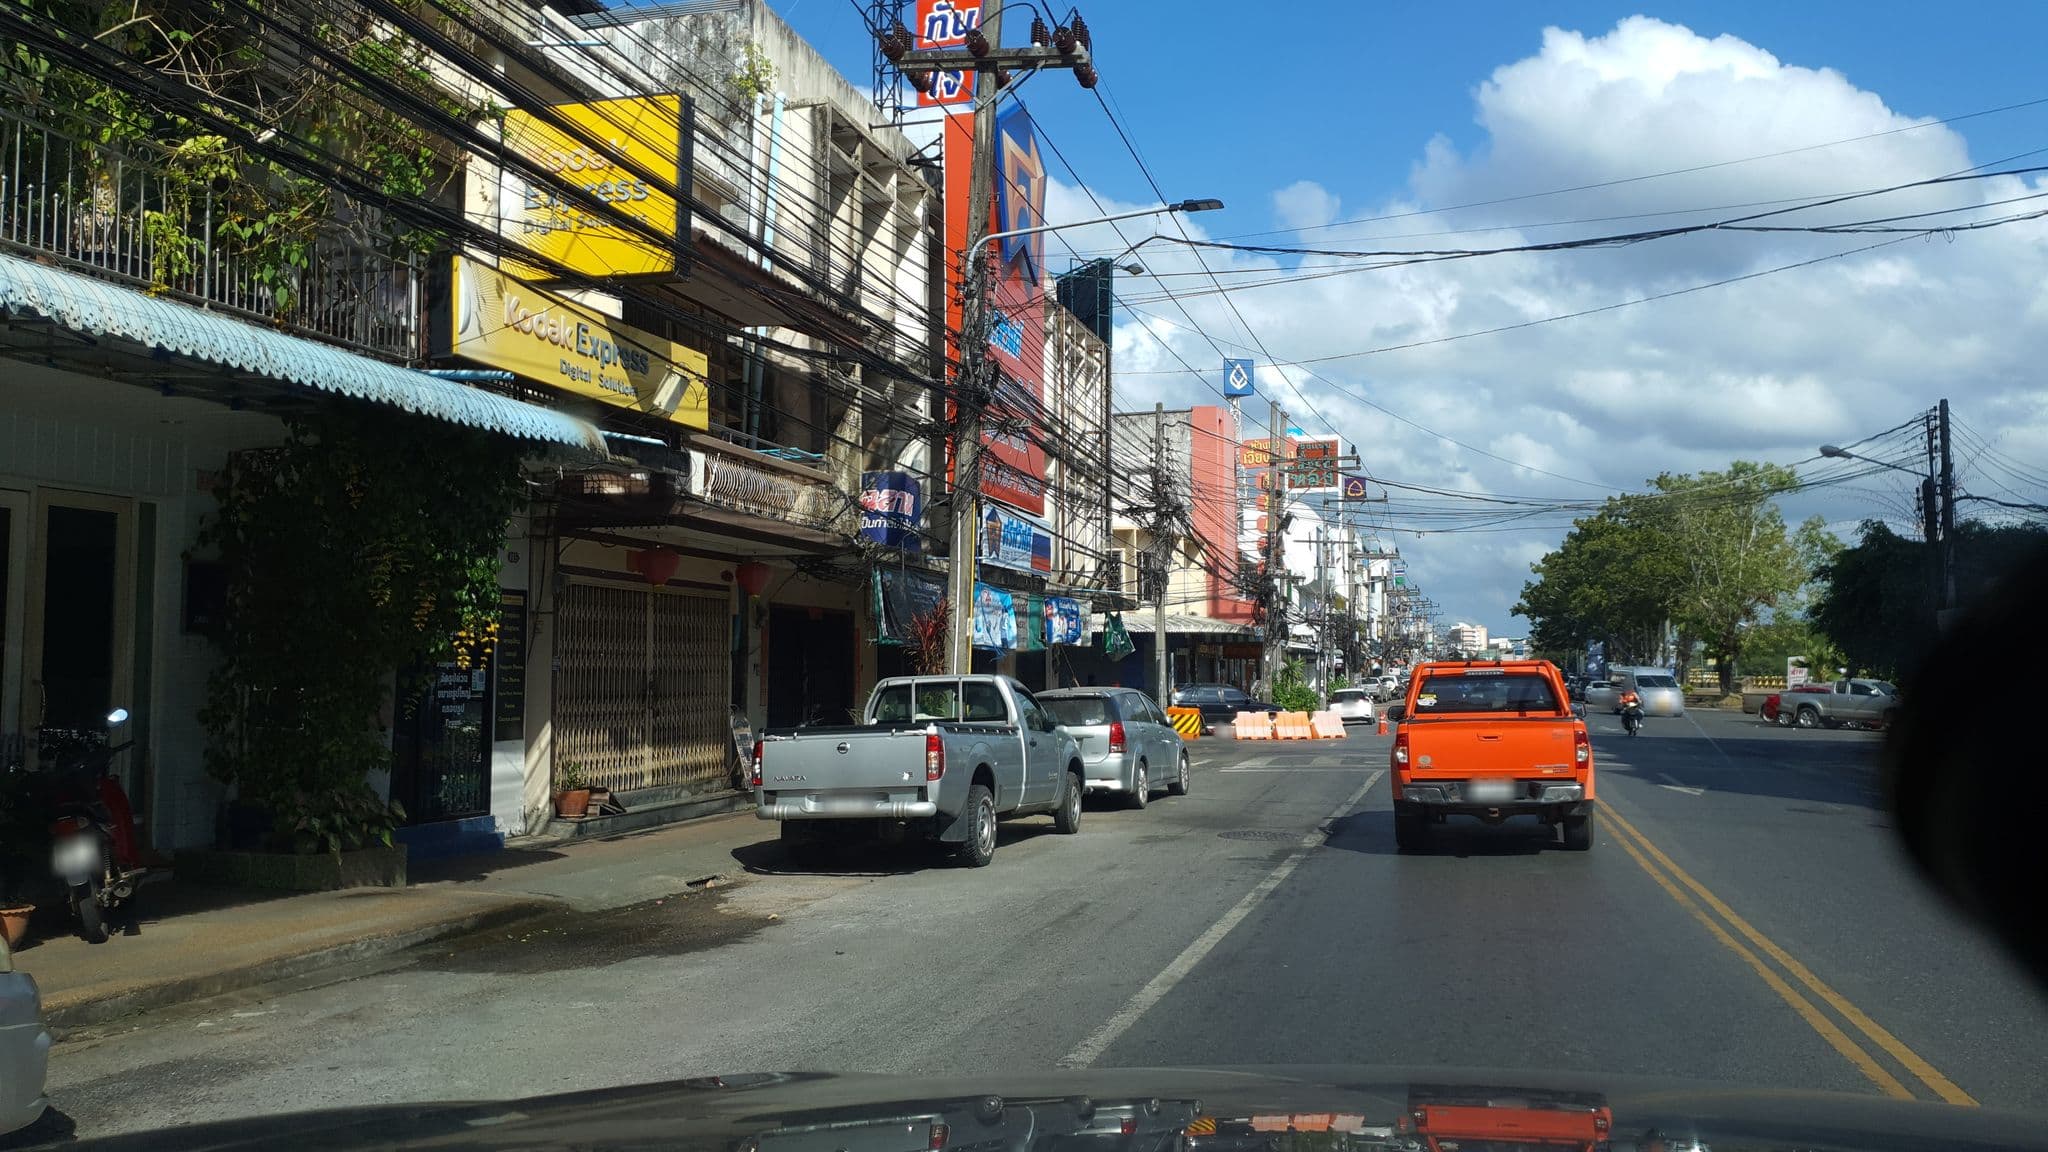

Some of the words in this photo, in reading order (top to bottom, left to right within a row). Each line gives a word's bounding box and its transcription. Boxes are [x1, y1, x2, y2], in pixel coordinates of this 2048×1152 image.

[527, 138, 628, 175] oda
[524, 178, 649, 214] Exess
[503, 292, 574, 351] Kodak
[576, 322, 649, 375] Express
[559, 358, 592, 384] Digital
